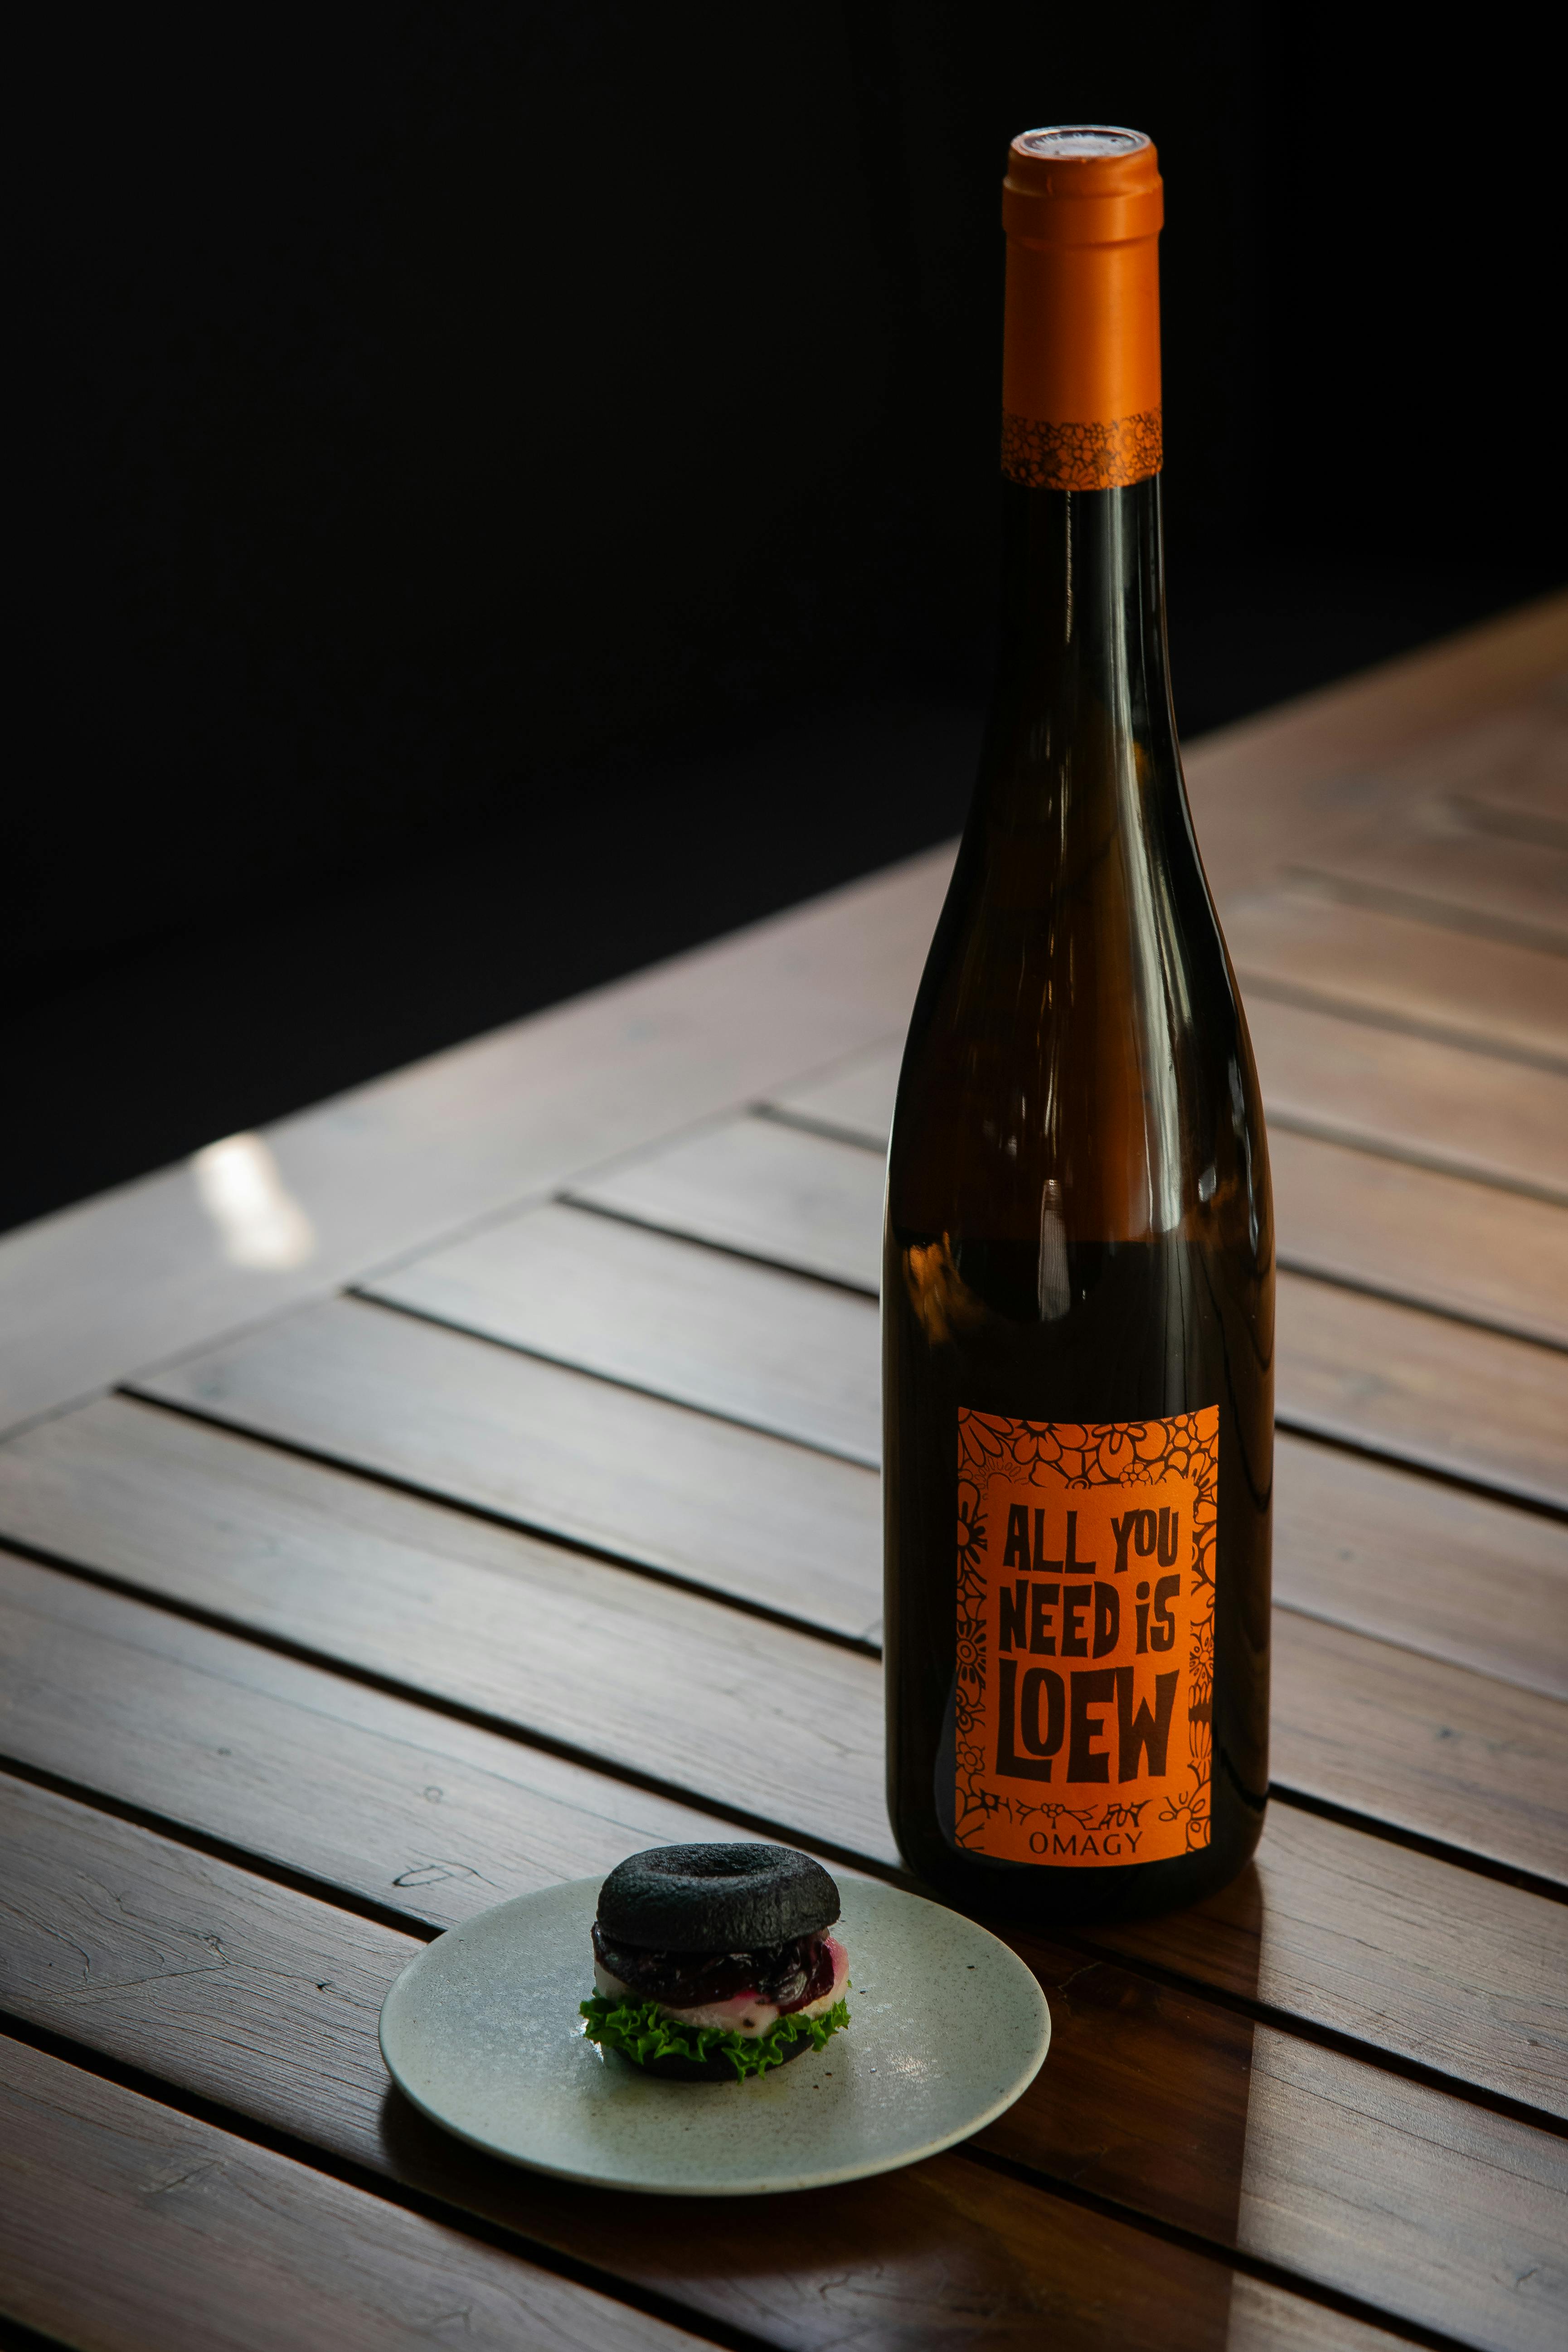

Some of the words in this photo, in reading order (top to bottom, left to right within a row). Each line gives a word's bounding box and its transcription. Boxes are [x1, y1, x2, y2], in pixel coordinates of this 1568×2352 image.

[1003, 1503, 1096, 1574] ALL
[1111, 1506, 1179, 1573] YOU
[999, 1580, 1120, 1659] NEED
[996, 1659, 1180, 1783] LOEW
[1029, 1832, 1143, 1856] OMAGY
